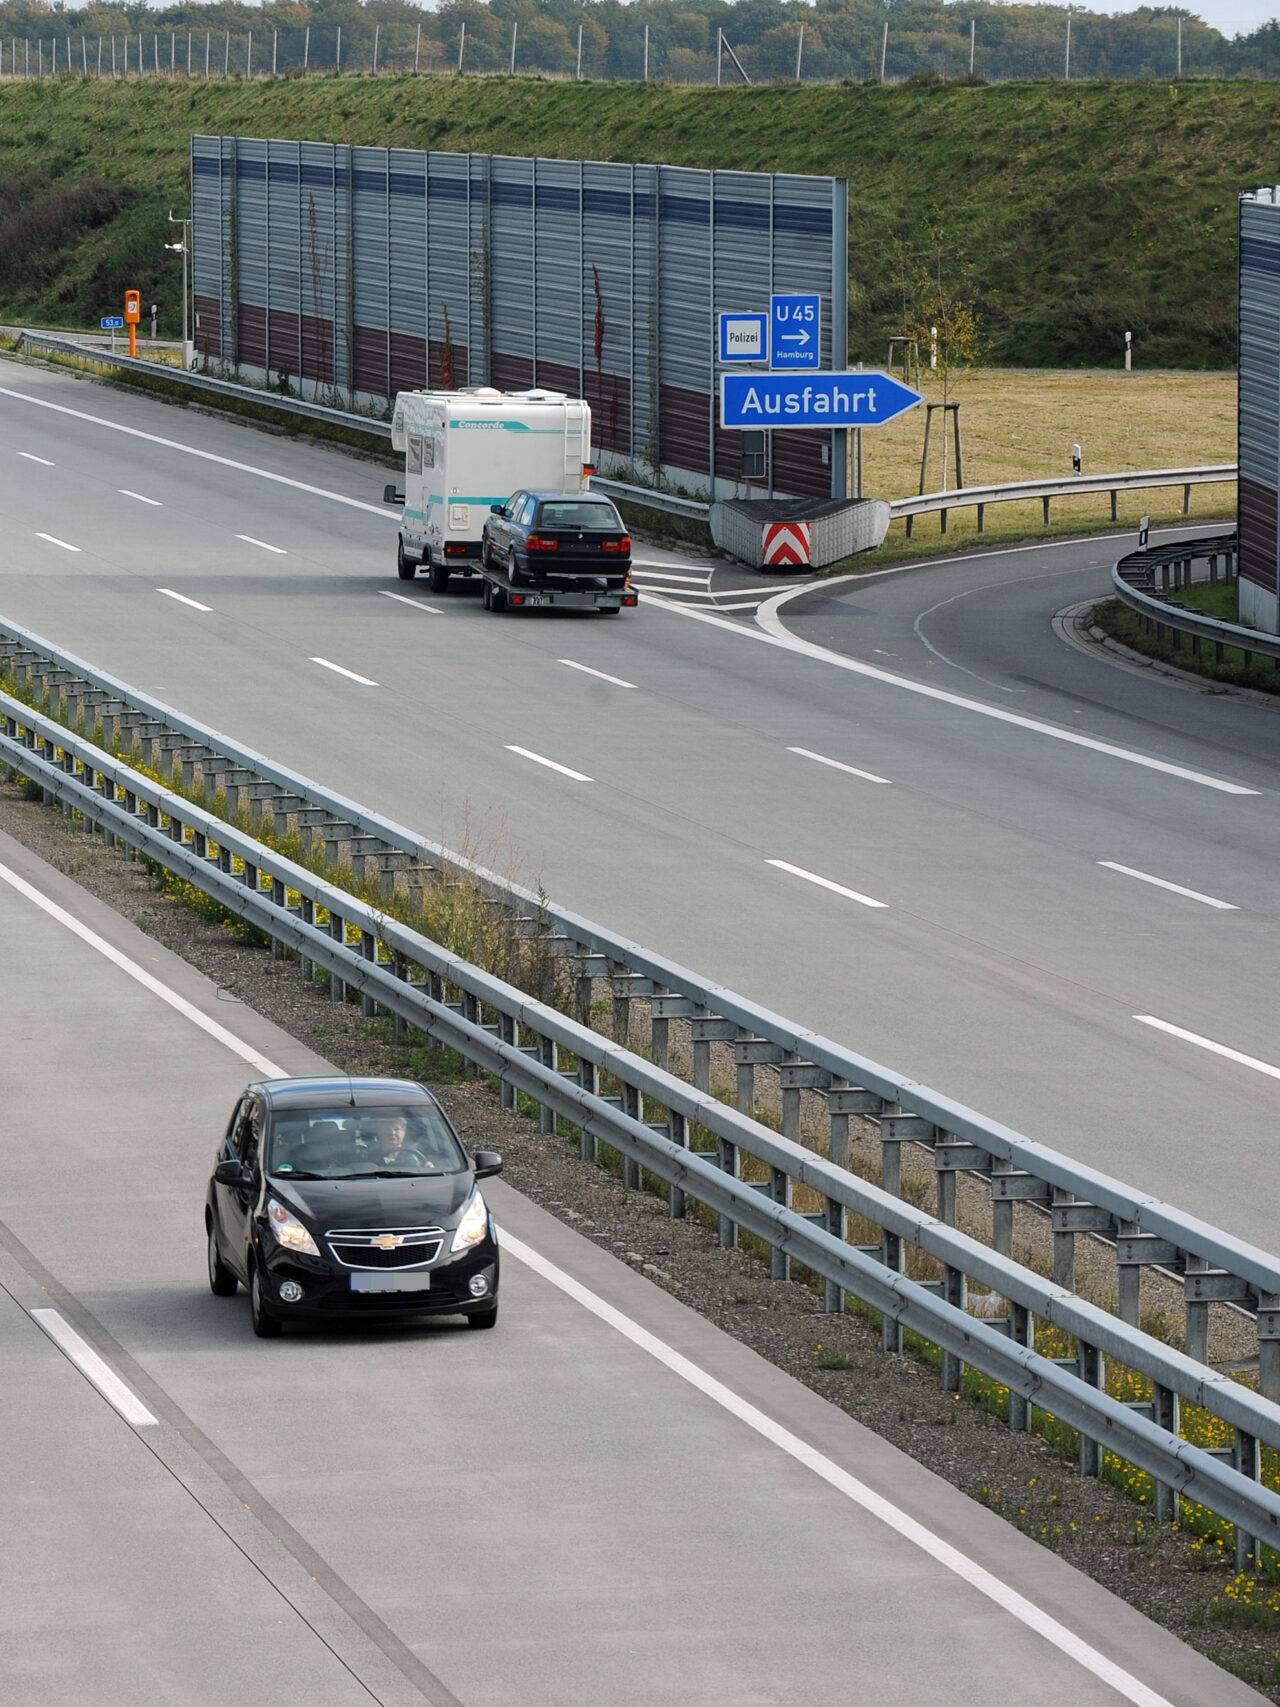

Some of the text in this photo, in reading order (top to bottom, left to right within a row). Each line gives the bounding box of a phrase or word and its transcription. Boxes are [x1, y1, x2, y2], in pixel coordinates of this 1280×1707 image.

[776, 305, 815, 321] U 45
[729, 332, 758, 343] Polizei
[777, 351, 814, 360] Hamburg
[741, 386, 877, 414] Ausfahrt
[458, 421, 505, 430] Concorde
